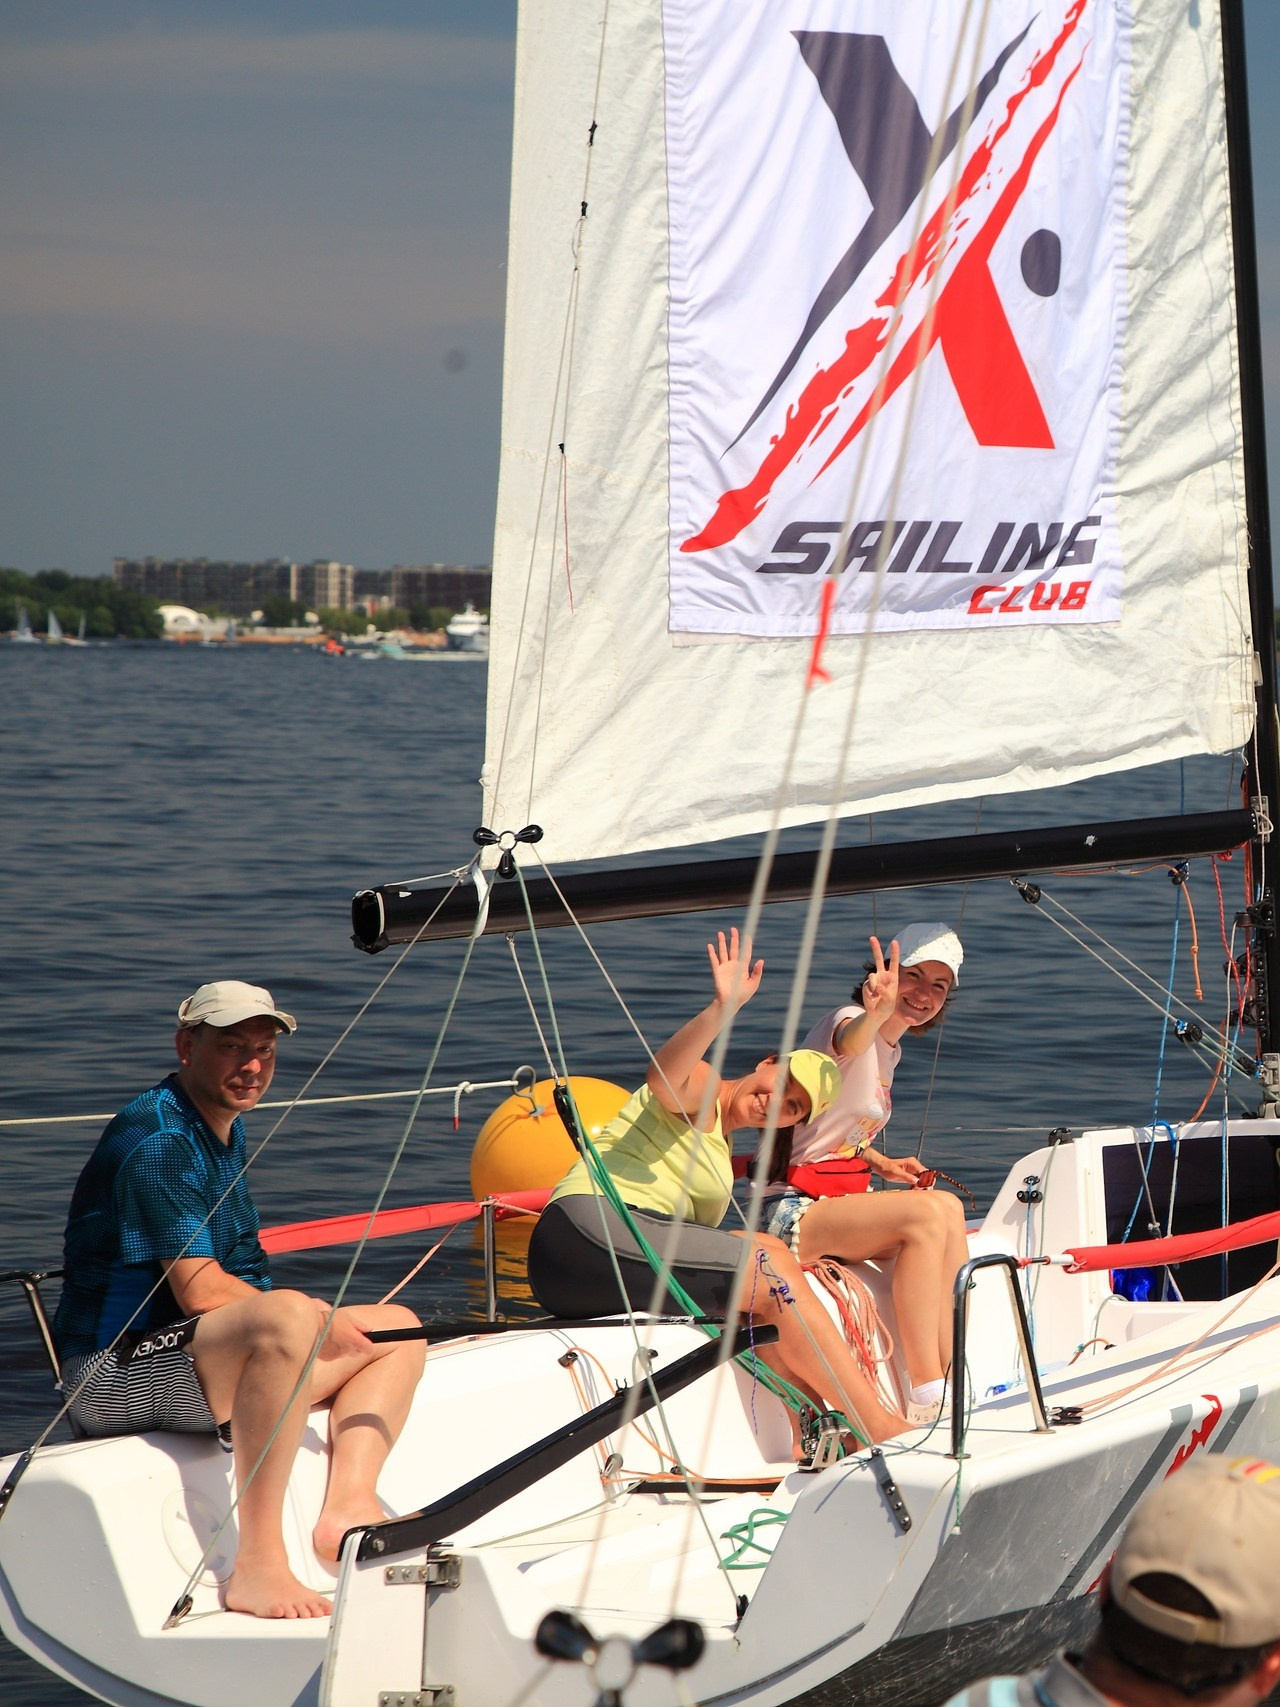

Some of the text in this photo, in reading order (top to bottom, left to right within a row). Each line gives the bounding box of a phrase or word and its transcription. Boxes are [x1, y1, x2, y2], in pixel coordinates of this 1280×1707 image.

[755, 515, 1101, 575] SAILING
[967, 580, 1092, 614] CLUB
[131, 1331, 184, 1358] JOCKEY
